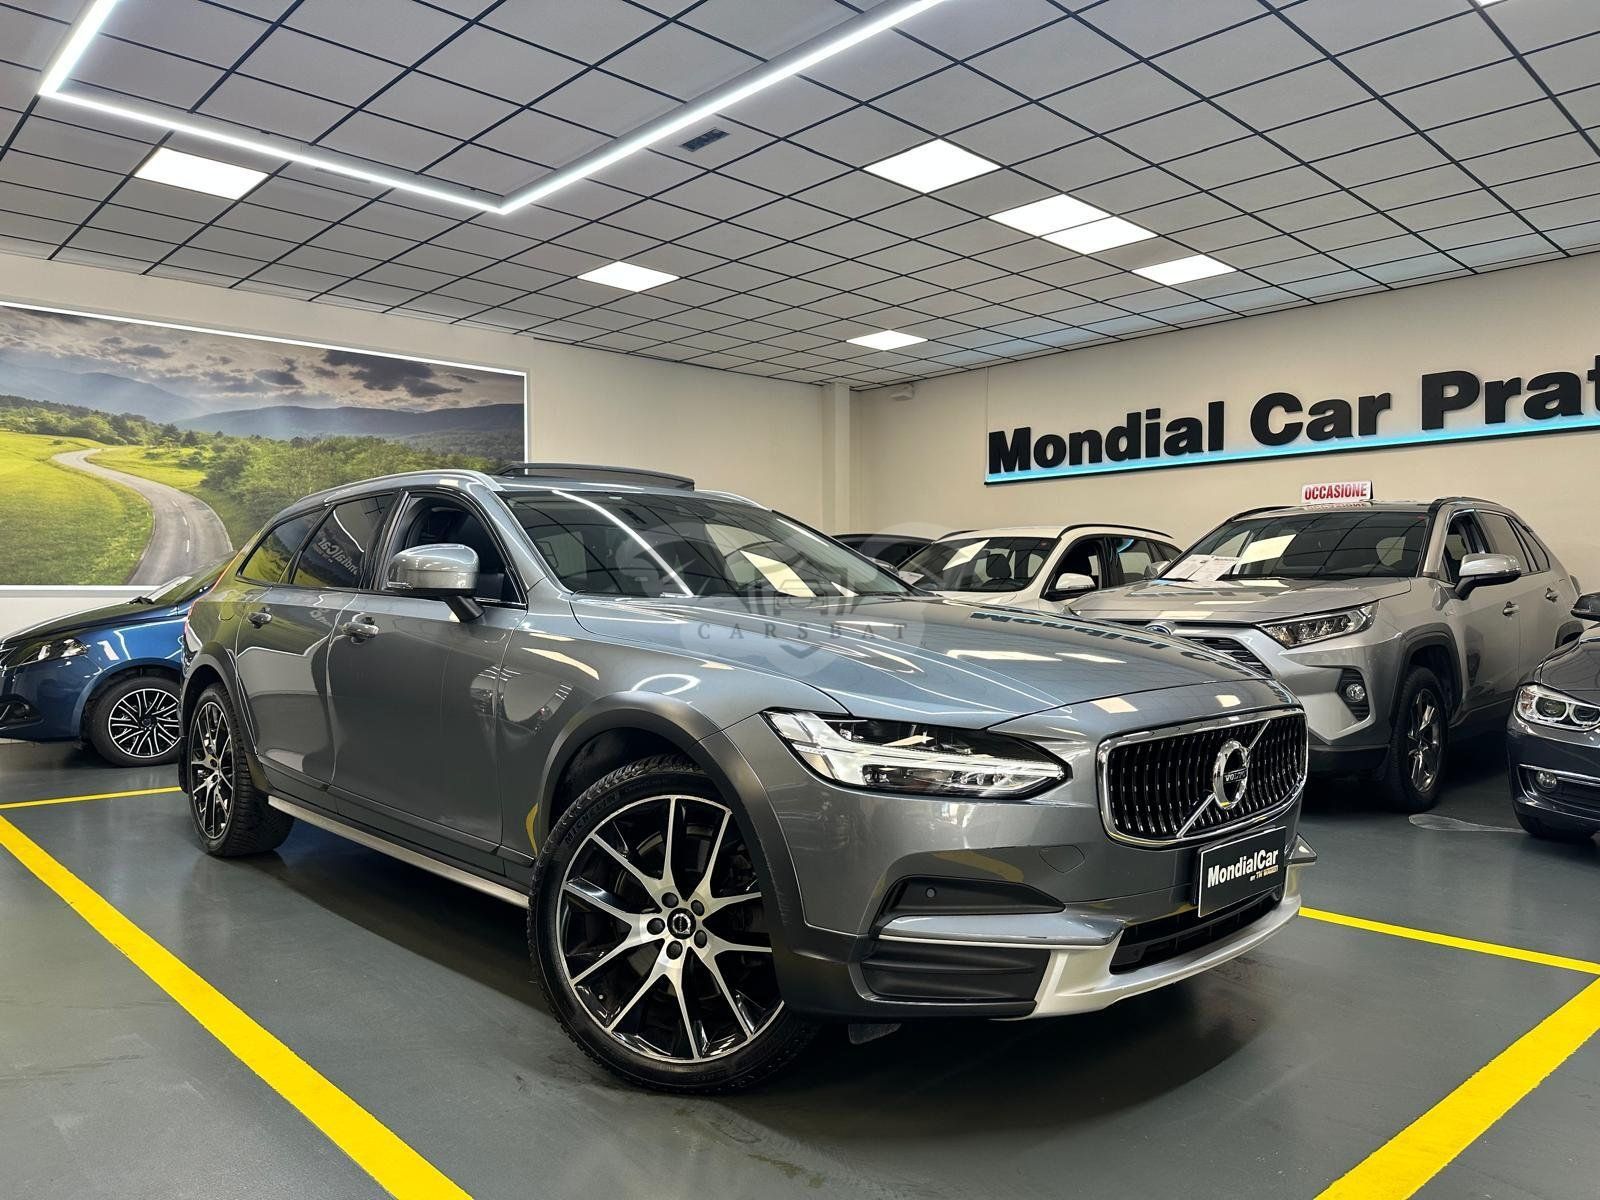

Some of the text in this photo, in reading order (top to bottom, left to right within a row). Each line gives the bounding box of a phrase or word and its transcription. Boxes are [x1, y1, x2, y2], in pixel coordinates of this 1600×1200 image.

[989, 401, 1225, 474] Mondial
[1250, 392, 1391, 446] Car
[1304, 483, 1368, 500] OCCASIONE
[1207, 849, 1279, 888] MondialCar
